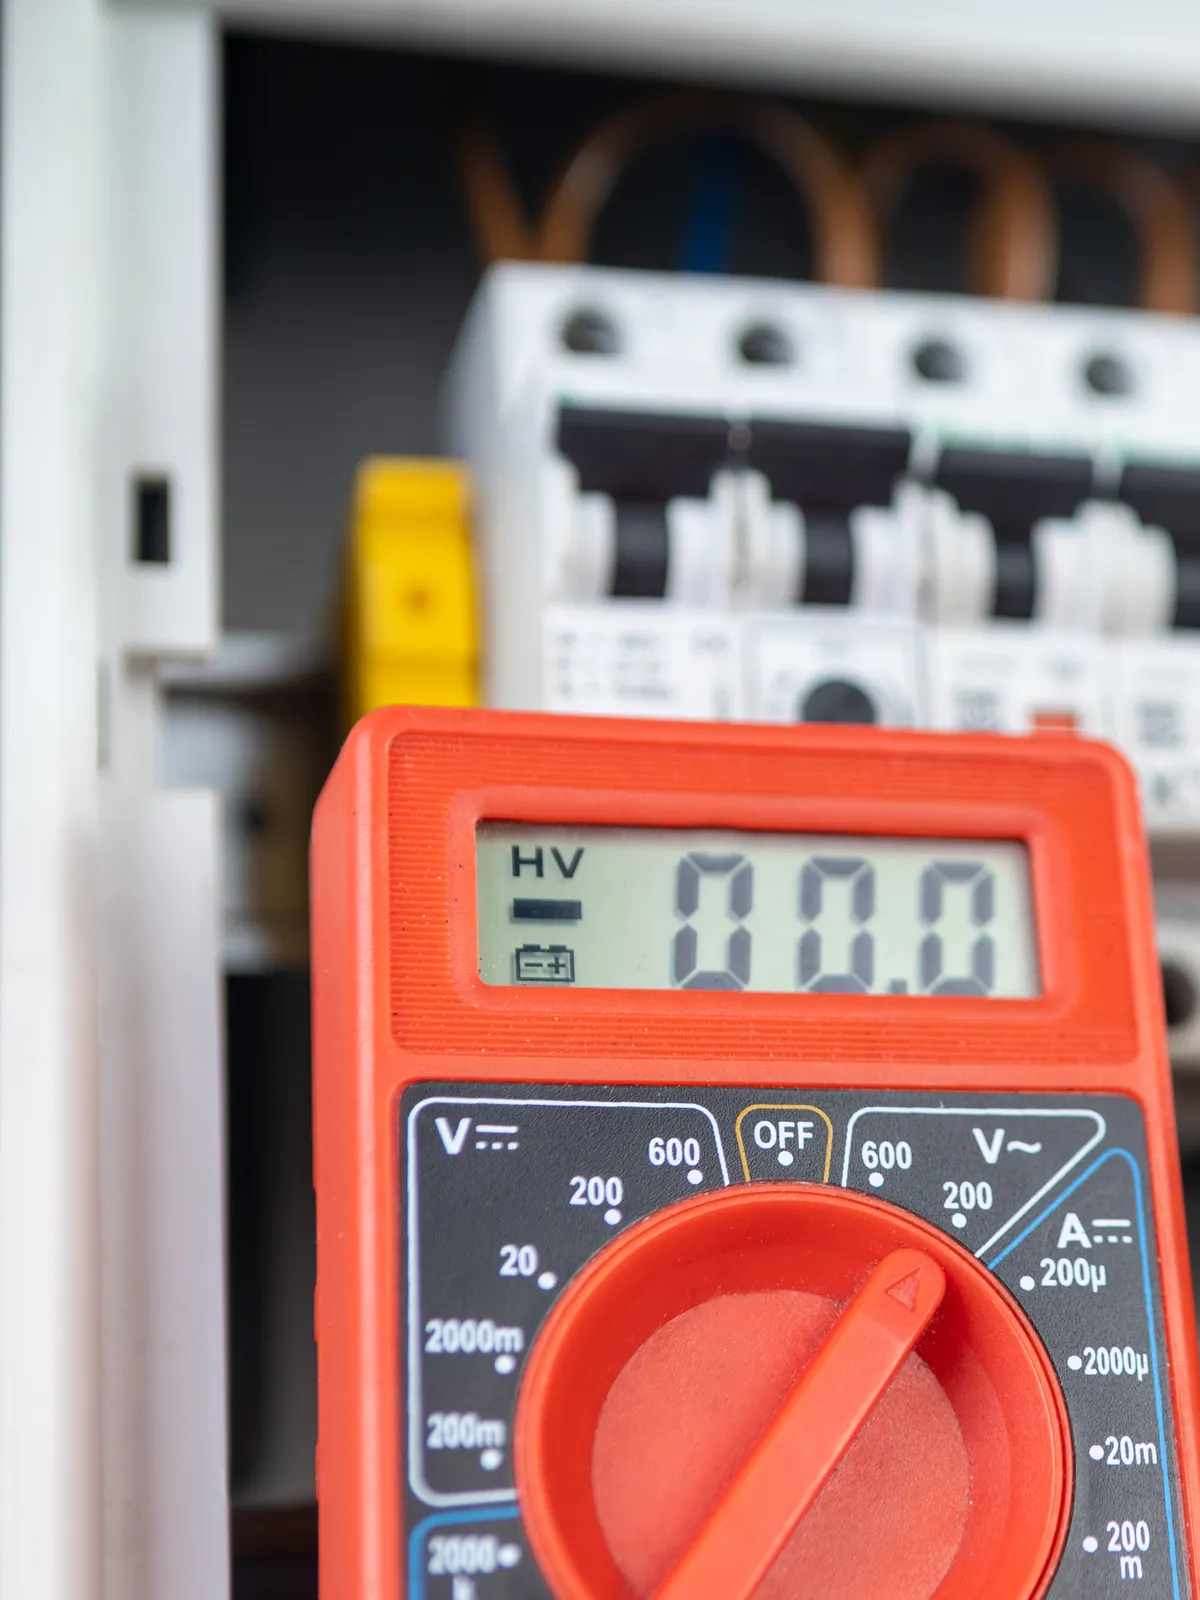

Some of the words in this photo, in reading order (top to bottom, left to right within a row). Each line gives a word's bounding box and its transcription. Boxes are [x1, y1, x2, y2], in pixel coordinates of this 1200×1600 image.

[511, 846, 585, 878] HV
[754, 1121, 814, 1149] OFF
[648, 1137, 700, 1166] 600
[862, 1141, 912, 1169] 600
[569, 1176, 623, 1206] 200
[943, 1181, 993, 1210] 200
[500, 1244, 539, 1276] 20
[425, 1319, 524, 1354] 2000m
[427, 1412, 506, 1450] 200m
[1105, 1436, 1158, 1465] 20m
[1107, 1520, 1150, 1551] 200
[428, 1535, 498, 1575] 2000
[1120, 1556, 1143, 1579] m
